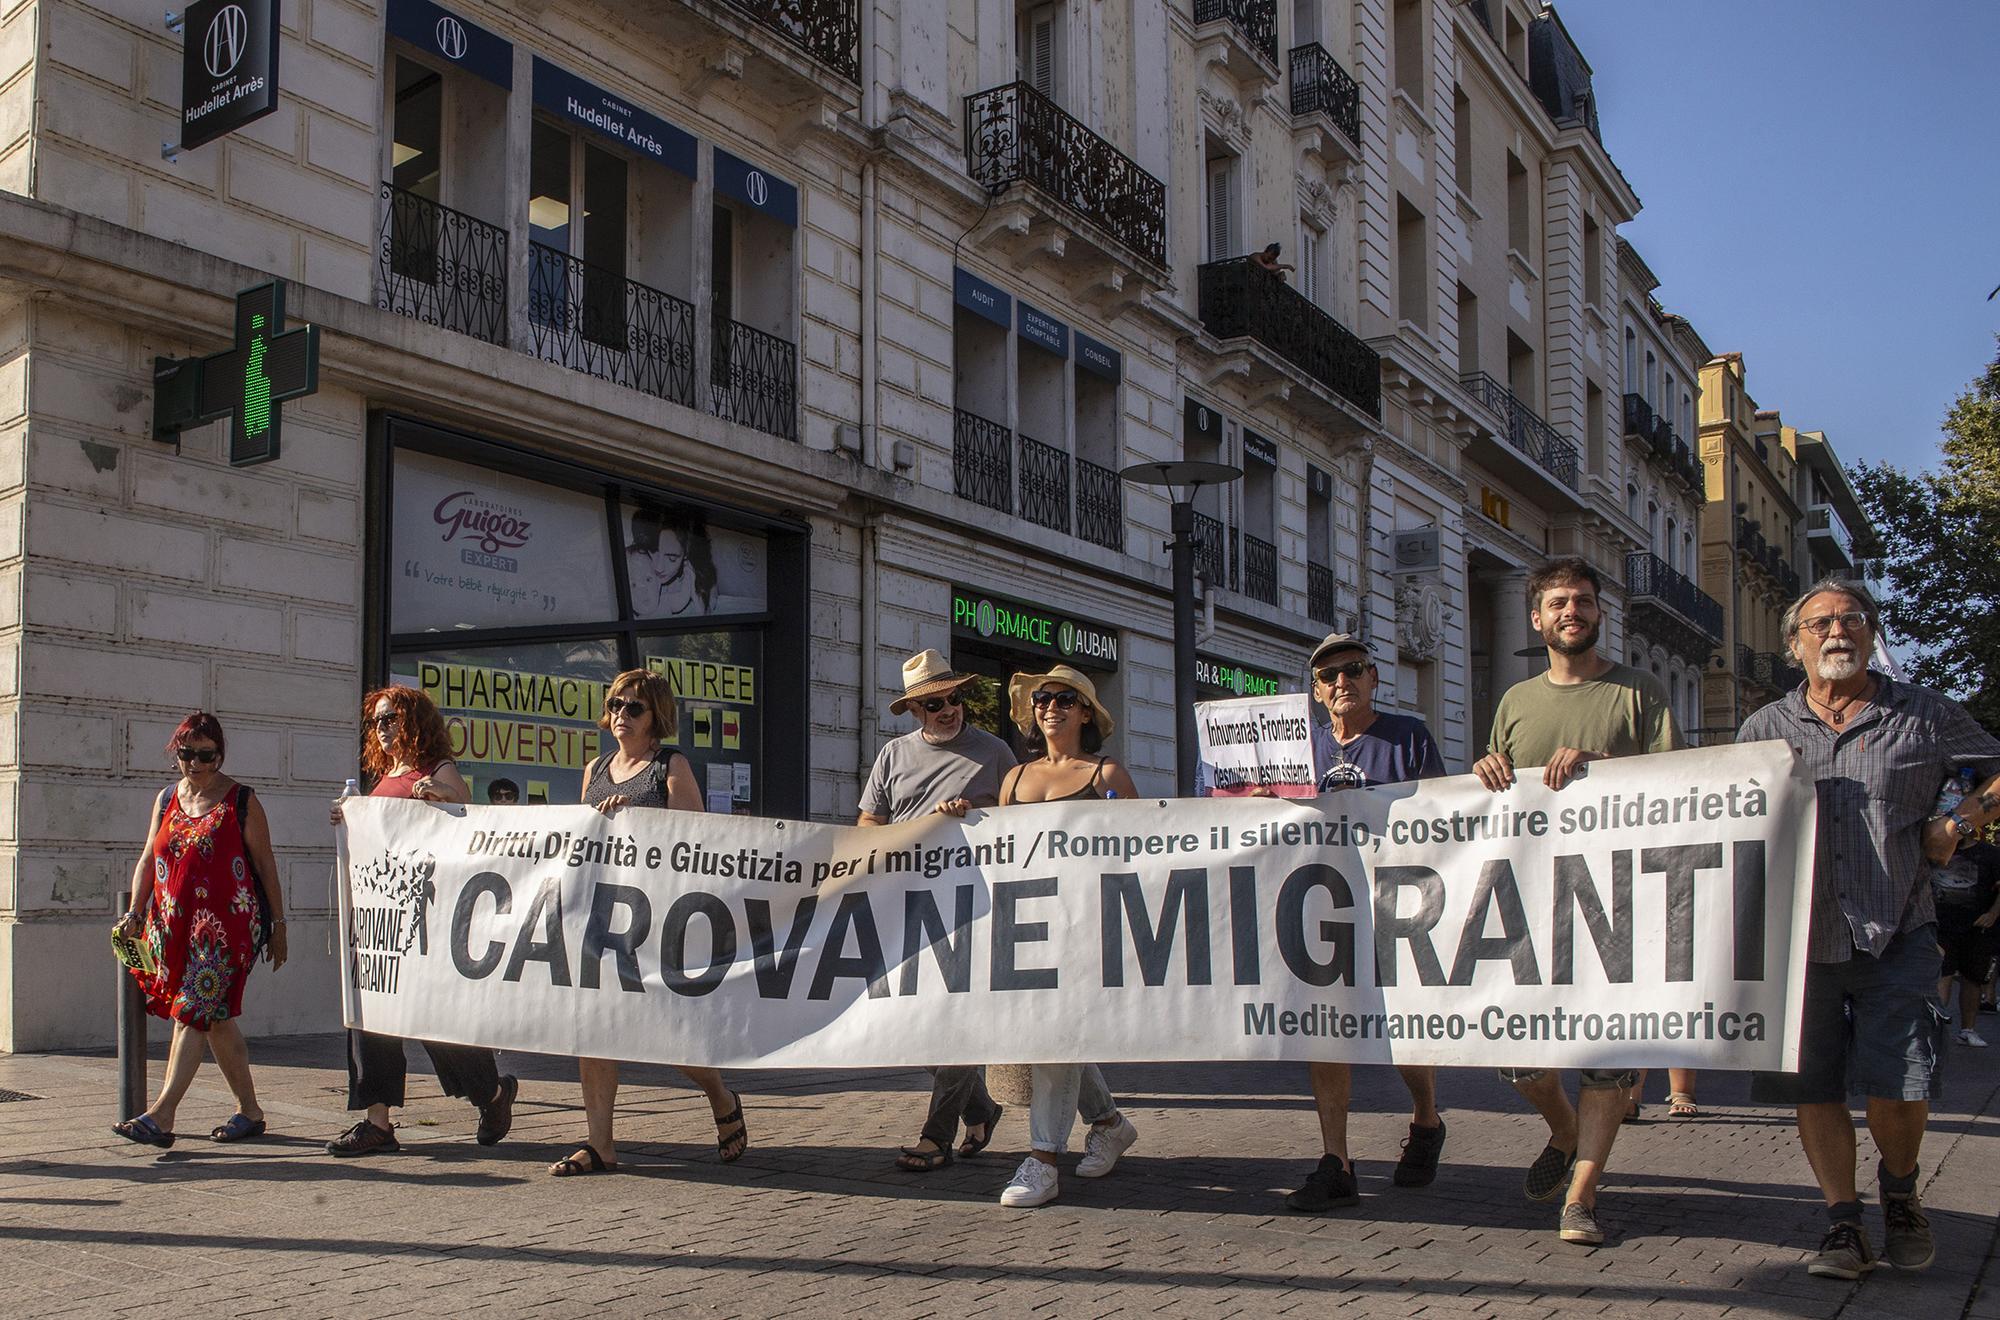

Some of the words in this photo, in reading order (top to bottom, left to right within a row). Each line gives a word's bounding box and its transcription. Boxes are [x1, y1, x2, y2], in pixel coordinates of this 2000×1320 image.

[185, 90, 230, 123] Hudellet
[233, 76, 264, 101] Arrès
[211, 75, 237, 93] CABINET
[567, 96, 624, 138] Hudellet
[627, 127, 662, 155] Arrès
[602, 97, 632, 118] CABINET
[972, 289, 995, 308] AUDIT
[1025, 323, 1060, 348] COMPTABLE
[1027, 313, 1058, 336] EXPERTISE
[1084, 347, 1112, 369] CONSEIL
[434, 491, 531, 554] Guigoz
[463, 497, 523, 517] LABORATOIRES
[465, 553, 514, 572] EXPERT
[955, 598, 1052, 646] PHARMACIE
[1063, 624, 1117, 662] VAUBAN
[446, 717, 598, 766] OUVERTE
[1206, 718, 1260, 747] Inhumanas
[1259, 713, 1307, 742] Fronteras
[646, 849, 661, 870] e
[670, 841, 801, 884] Giustizia
[811, 857, 860, 888] per
[868, 849, 877, 875] i
[885, 834, 1014, 879] migranti
[1210, 826, 1229, 850] il
[1240, 815, 1382, 853] silenzio,
[1391, 805, 1548, 844] costruire
[1559, 777, 1767, 835] solidarietà
[349, 906, 406, 953] CAROVANE
[451, 871, 1058, 1000] CAROVANE
[1100, 840, 1765, 988] MIGRANTI
[1244, 1002, 1765, 1041] Mediterraneo-Centroamerica
